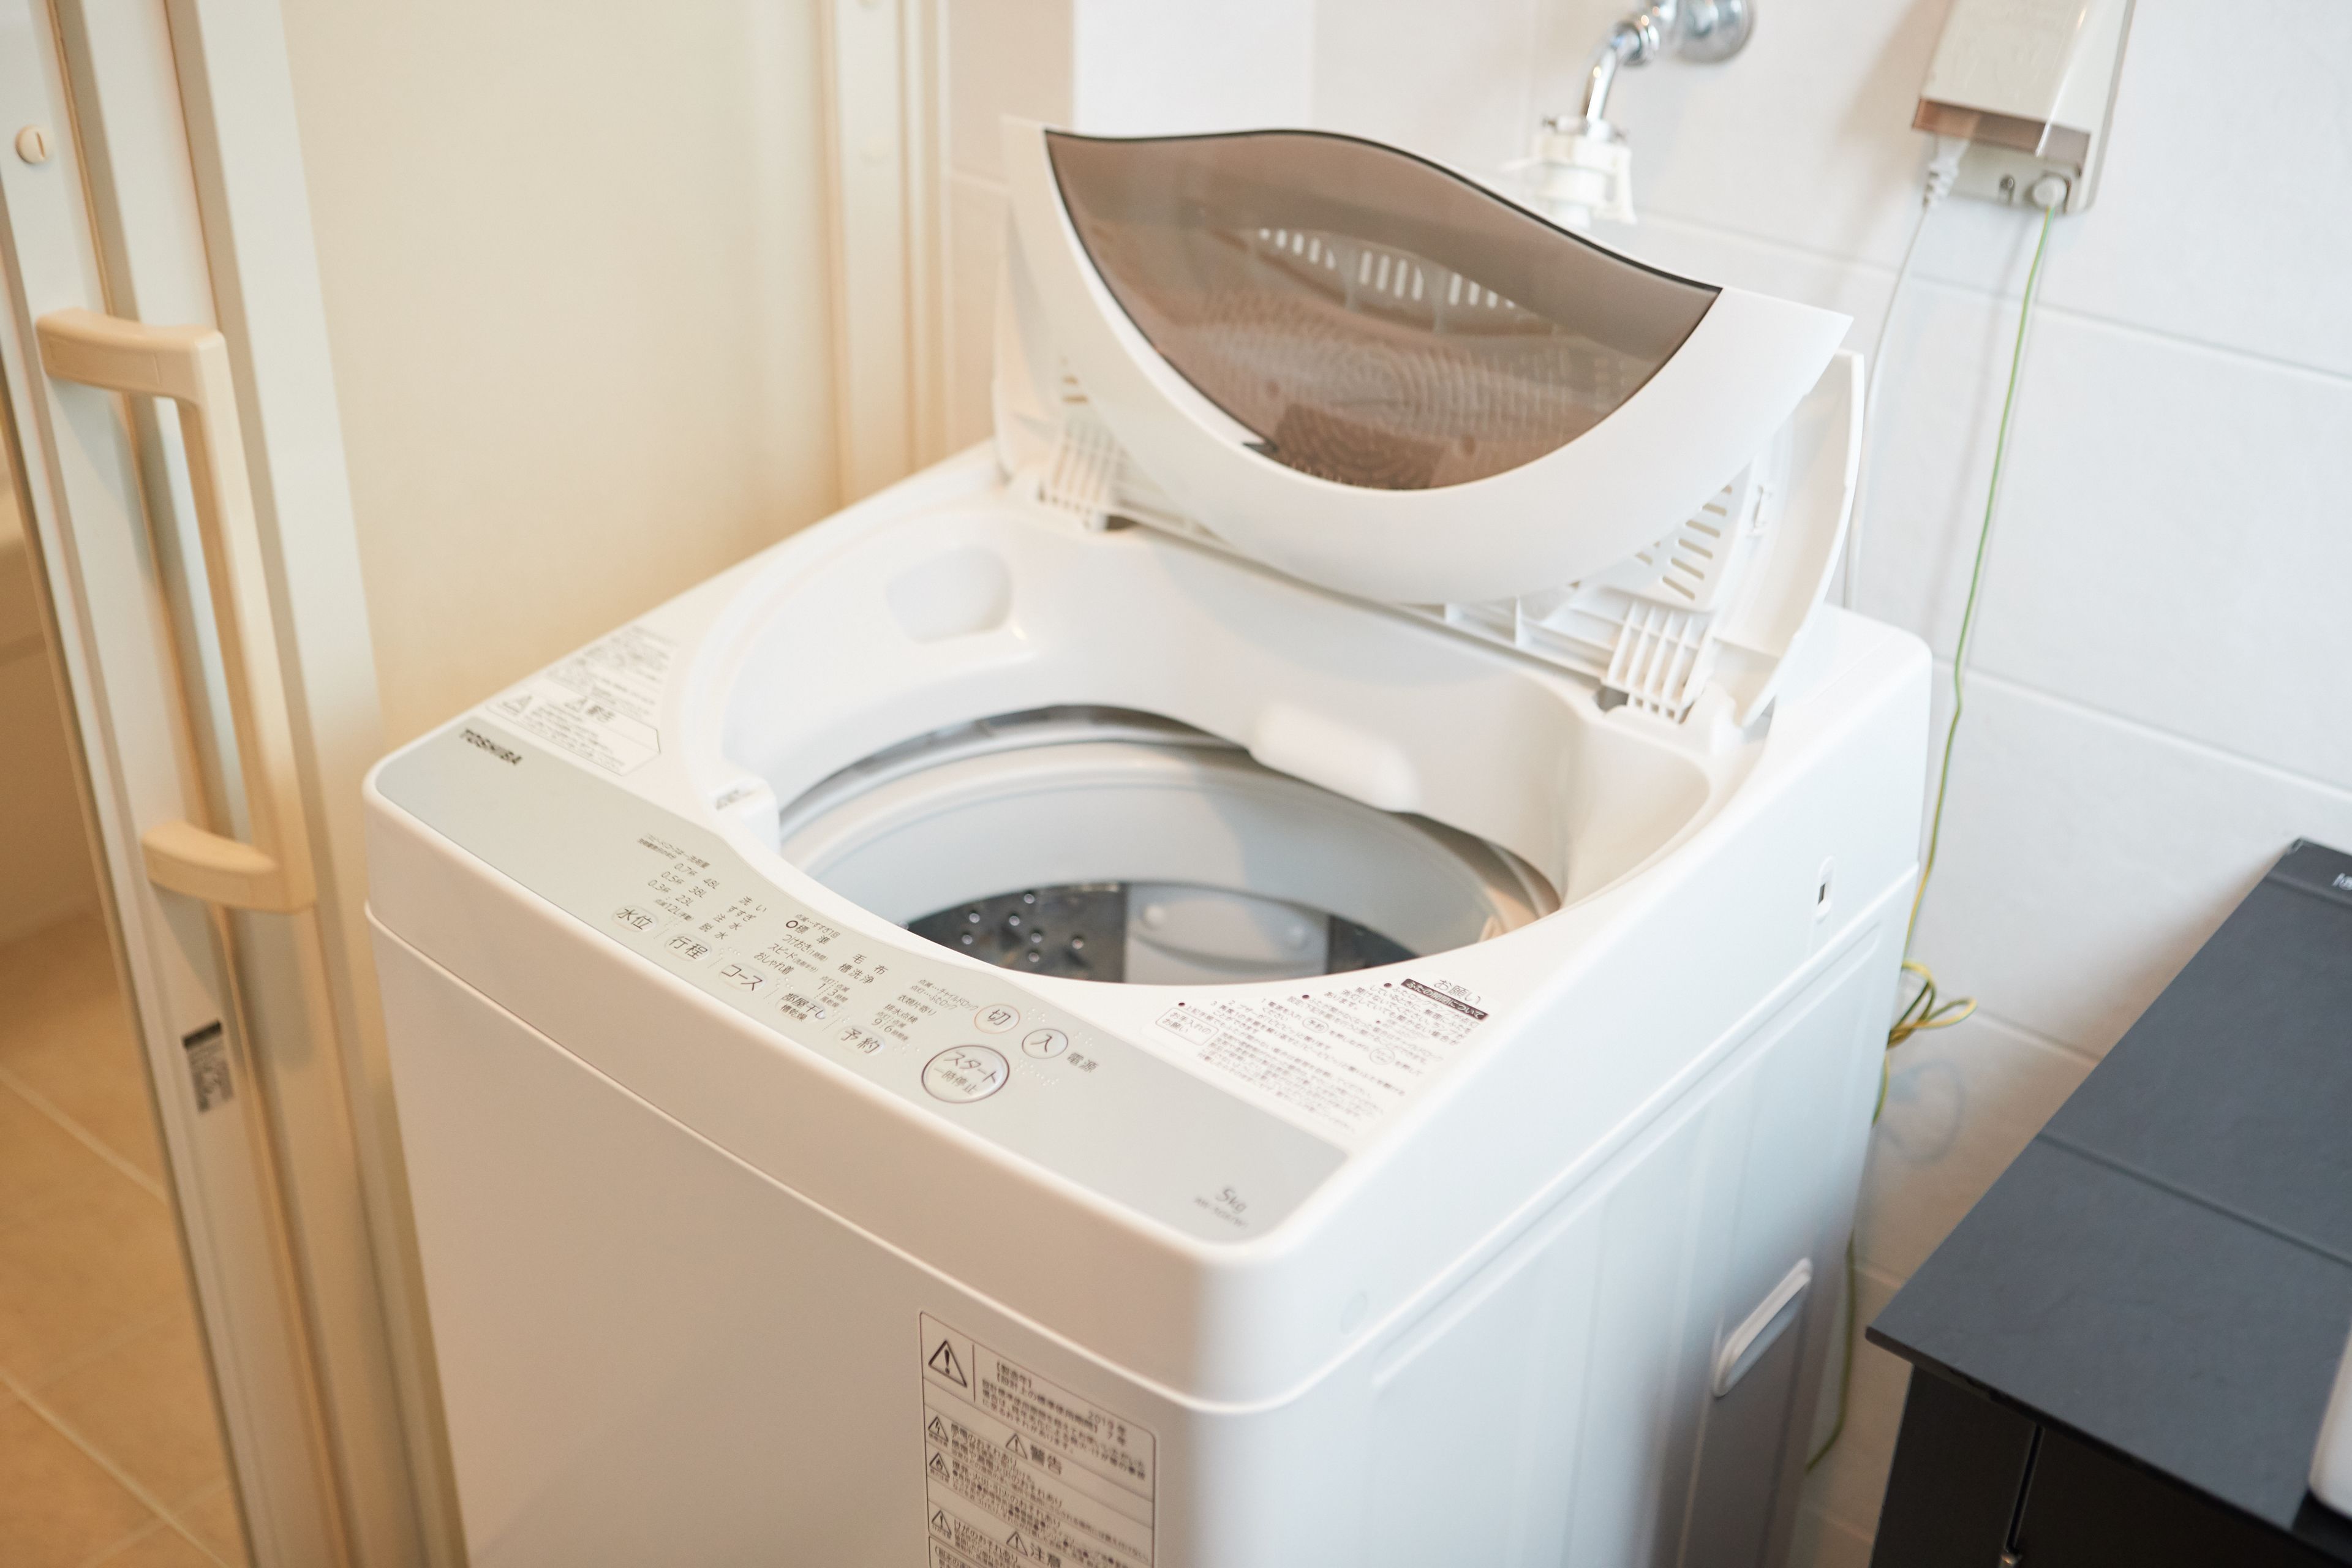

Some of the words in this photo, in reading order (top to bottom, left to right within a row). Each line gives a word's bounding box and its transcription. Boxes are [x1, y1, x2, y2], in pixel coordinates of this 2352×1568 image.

[674, 894, 693, 907] 23L
[688, 886, 706, 899] 38L
[616, 907, 653, 930] 水位
[727, 905, 756, 922] すすぎ
[668, 935, 708, 960] 行程
[753, 952, 794, 975] おしゃれ着
[837, 963, 875, 984] 槽洗浄
[852, 953, 889, 975] 毛布
[721, 963, 763, 991] コース
[1433, 979, 1480, 1005] お願い
[781, 993, 826, 1020] 部屋干し
[883, 1003, 918, 1025] 排水点検
[896, 993, 937, 1017] 衣類片寄り
[987, 1008, 1012, 1026] 切
[840, 1027, 880, 1054] 予約
[1030, 1033, 1053, 1054] 入
[944, 1050, 999, 1084] スタート
[1067, 1052, 1100, 1074] 電源
[933, 1067, 978, 1095] 一時停止
